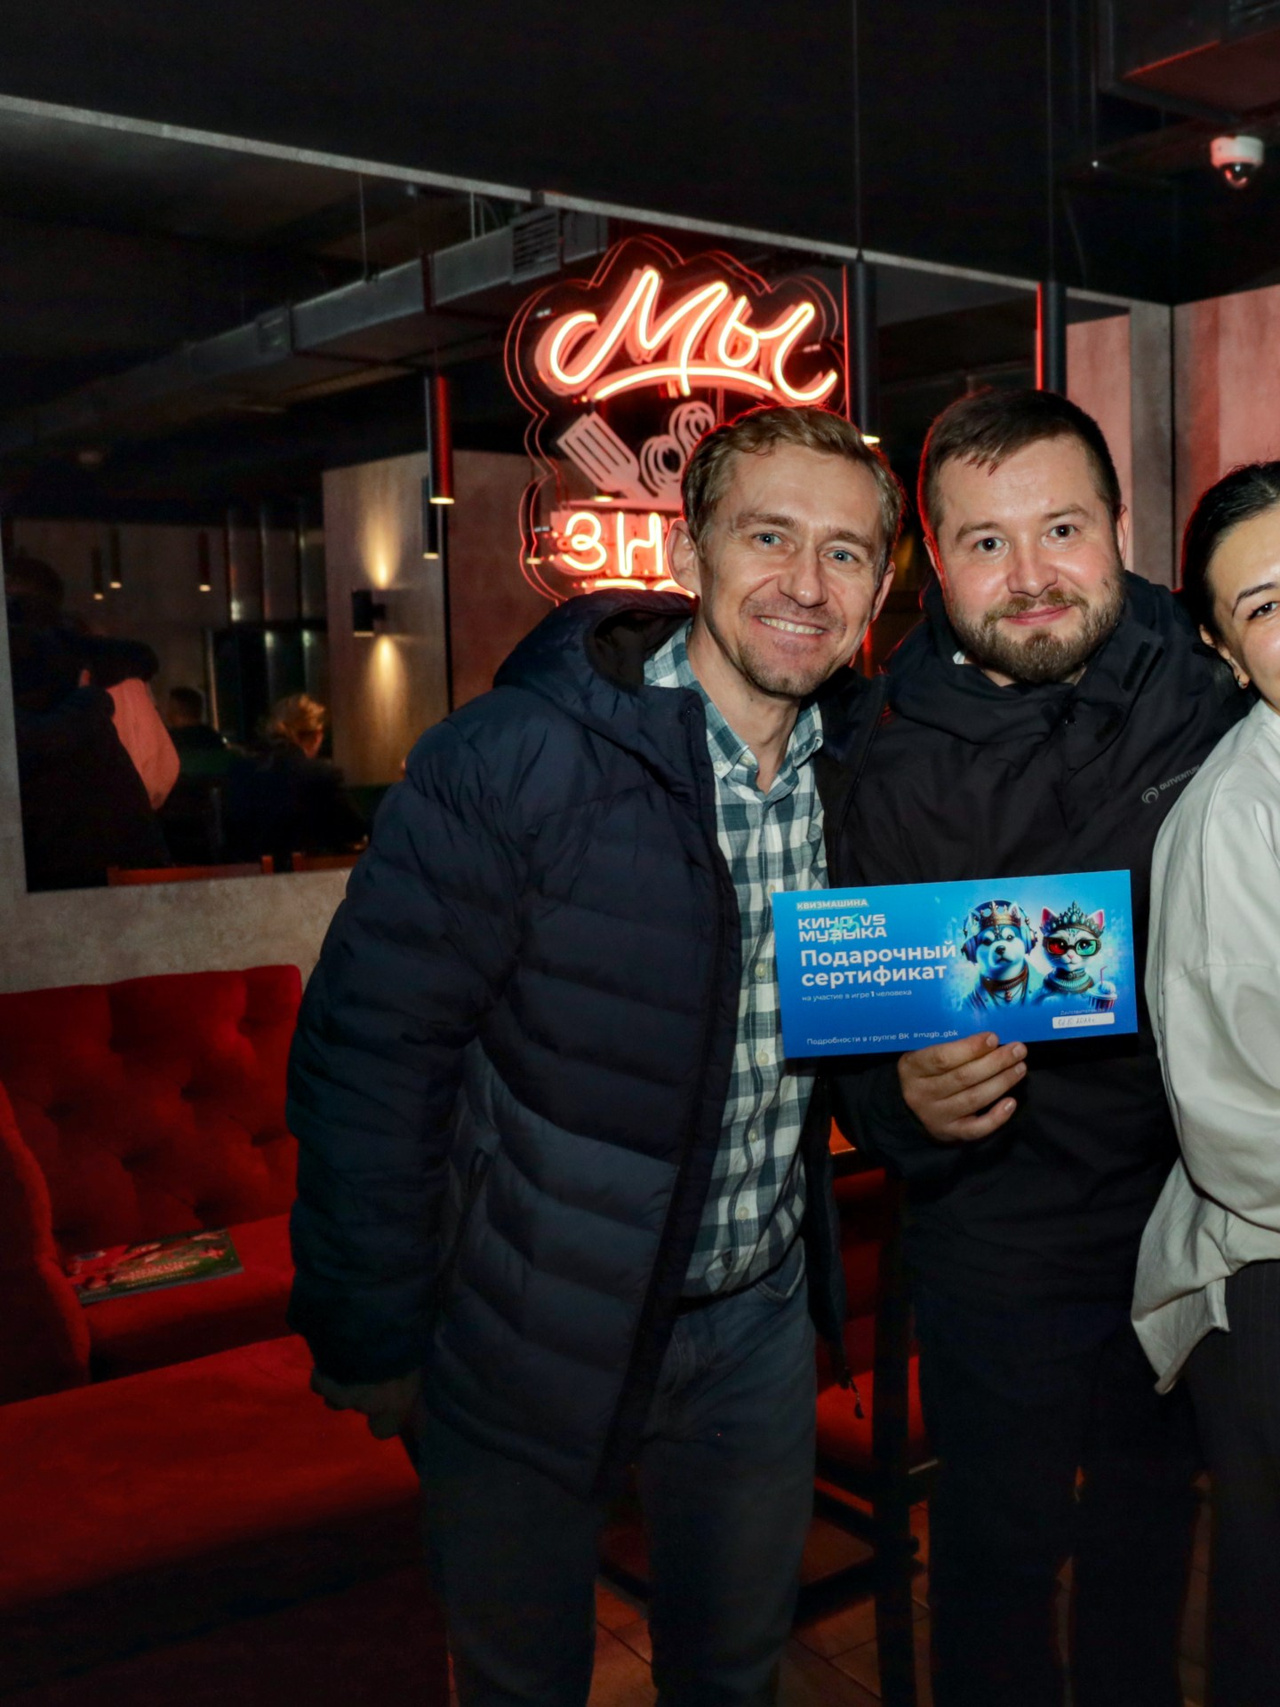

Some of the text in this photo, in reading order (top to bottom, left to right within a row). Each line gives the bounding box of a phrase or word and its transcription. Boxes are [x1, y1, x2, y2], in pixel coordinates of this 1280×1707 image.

[561, 511, 664, 577] ЗН
[796, 898, 869, 911] КВИЗМАШИНА
[798, 913, 887, 930] КИНО VS
[799, 926, 888, 943] МУЗЫКА
[800, 940, 957, 968] Подарочный
[801, 965, 948, 989] сертификат
[812, 993, 843, 1002] участие
[851, 992, 870, 1001] игре
[876, 989, 912, 997] человека
[806, 1036, 861, 1046] Подробности
[869, 1033, 897, 1042] группе
[898, 1032, 910, 1040] ВК
